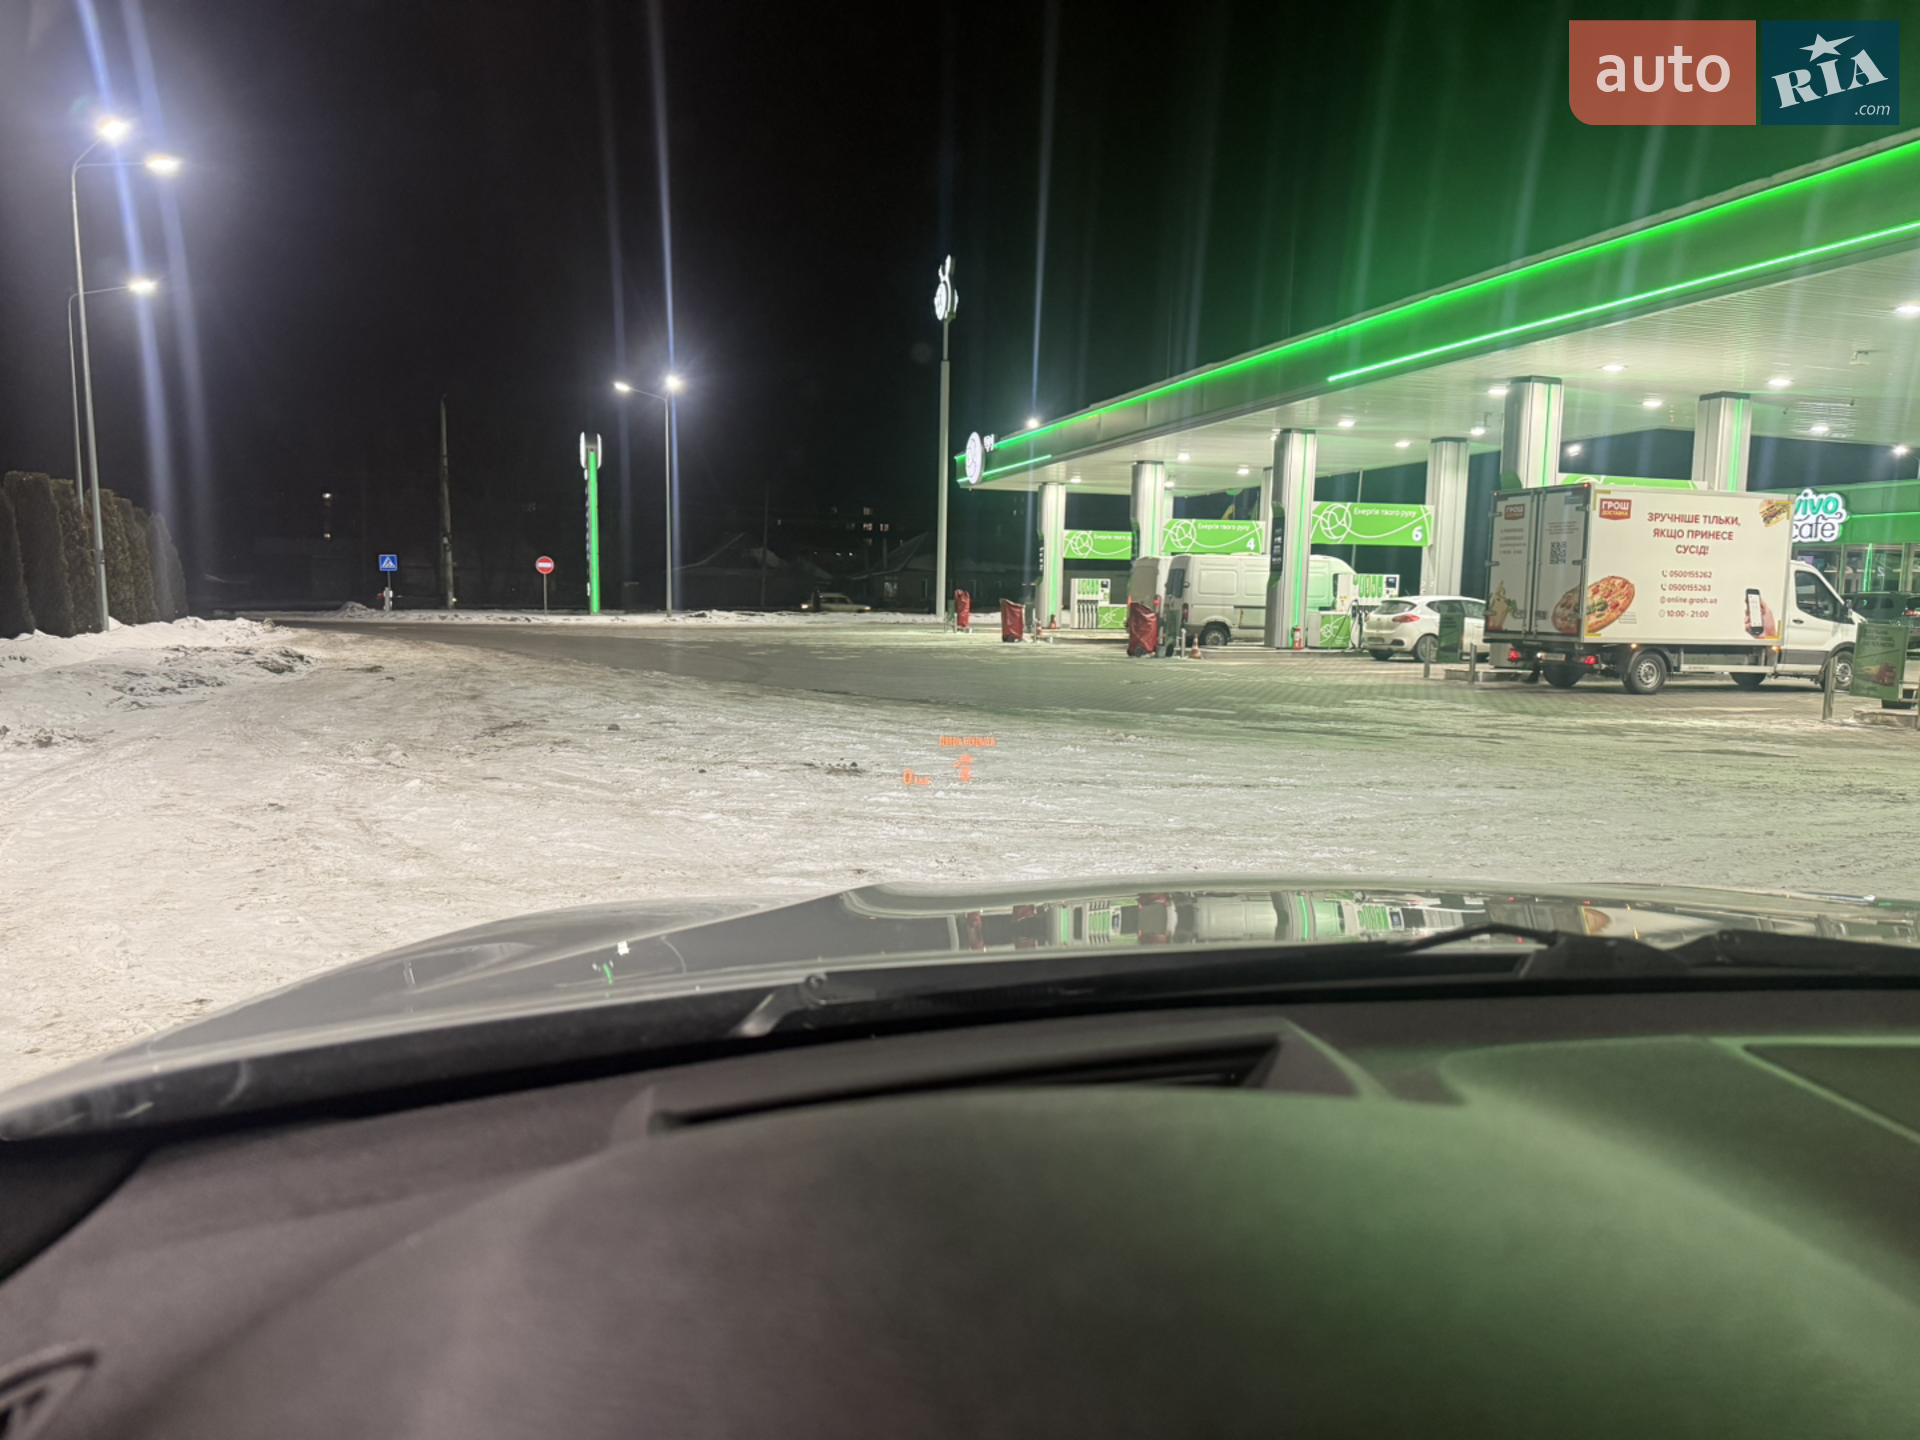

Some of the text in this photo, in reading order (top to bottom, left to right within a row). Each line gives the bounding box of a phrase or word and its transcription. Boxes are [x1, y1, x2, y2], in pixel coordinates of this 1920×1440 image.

[1602, 500, 1630, 510] ГРОШ
[1647, 512, 1741, 526] ЗРУЧНІШЕ ТІЛЬКИ,
[1412, 525, 1423, 541] 6
[1652, 528, 1735, 541] ЯКЩО ПРИНЕСЕ
[1245, 538, 1256, 550] 4
[1675, 544, 1710, 556] СУСІД!
